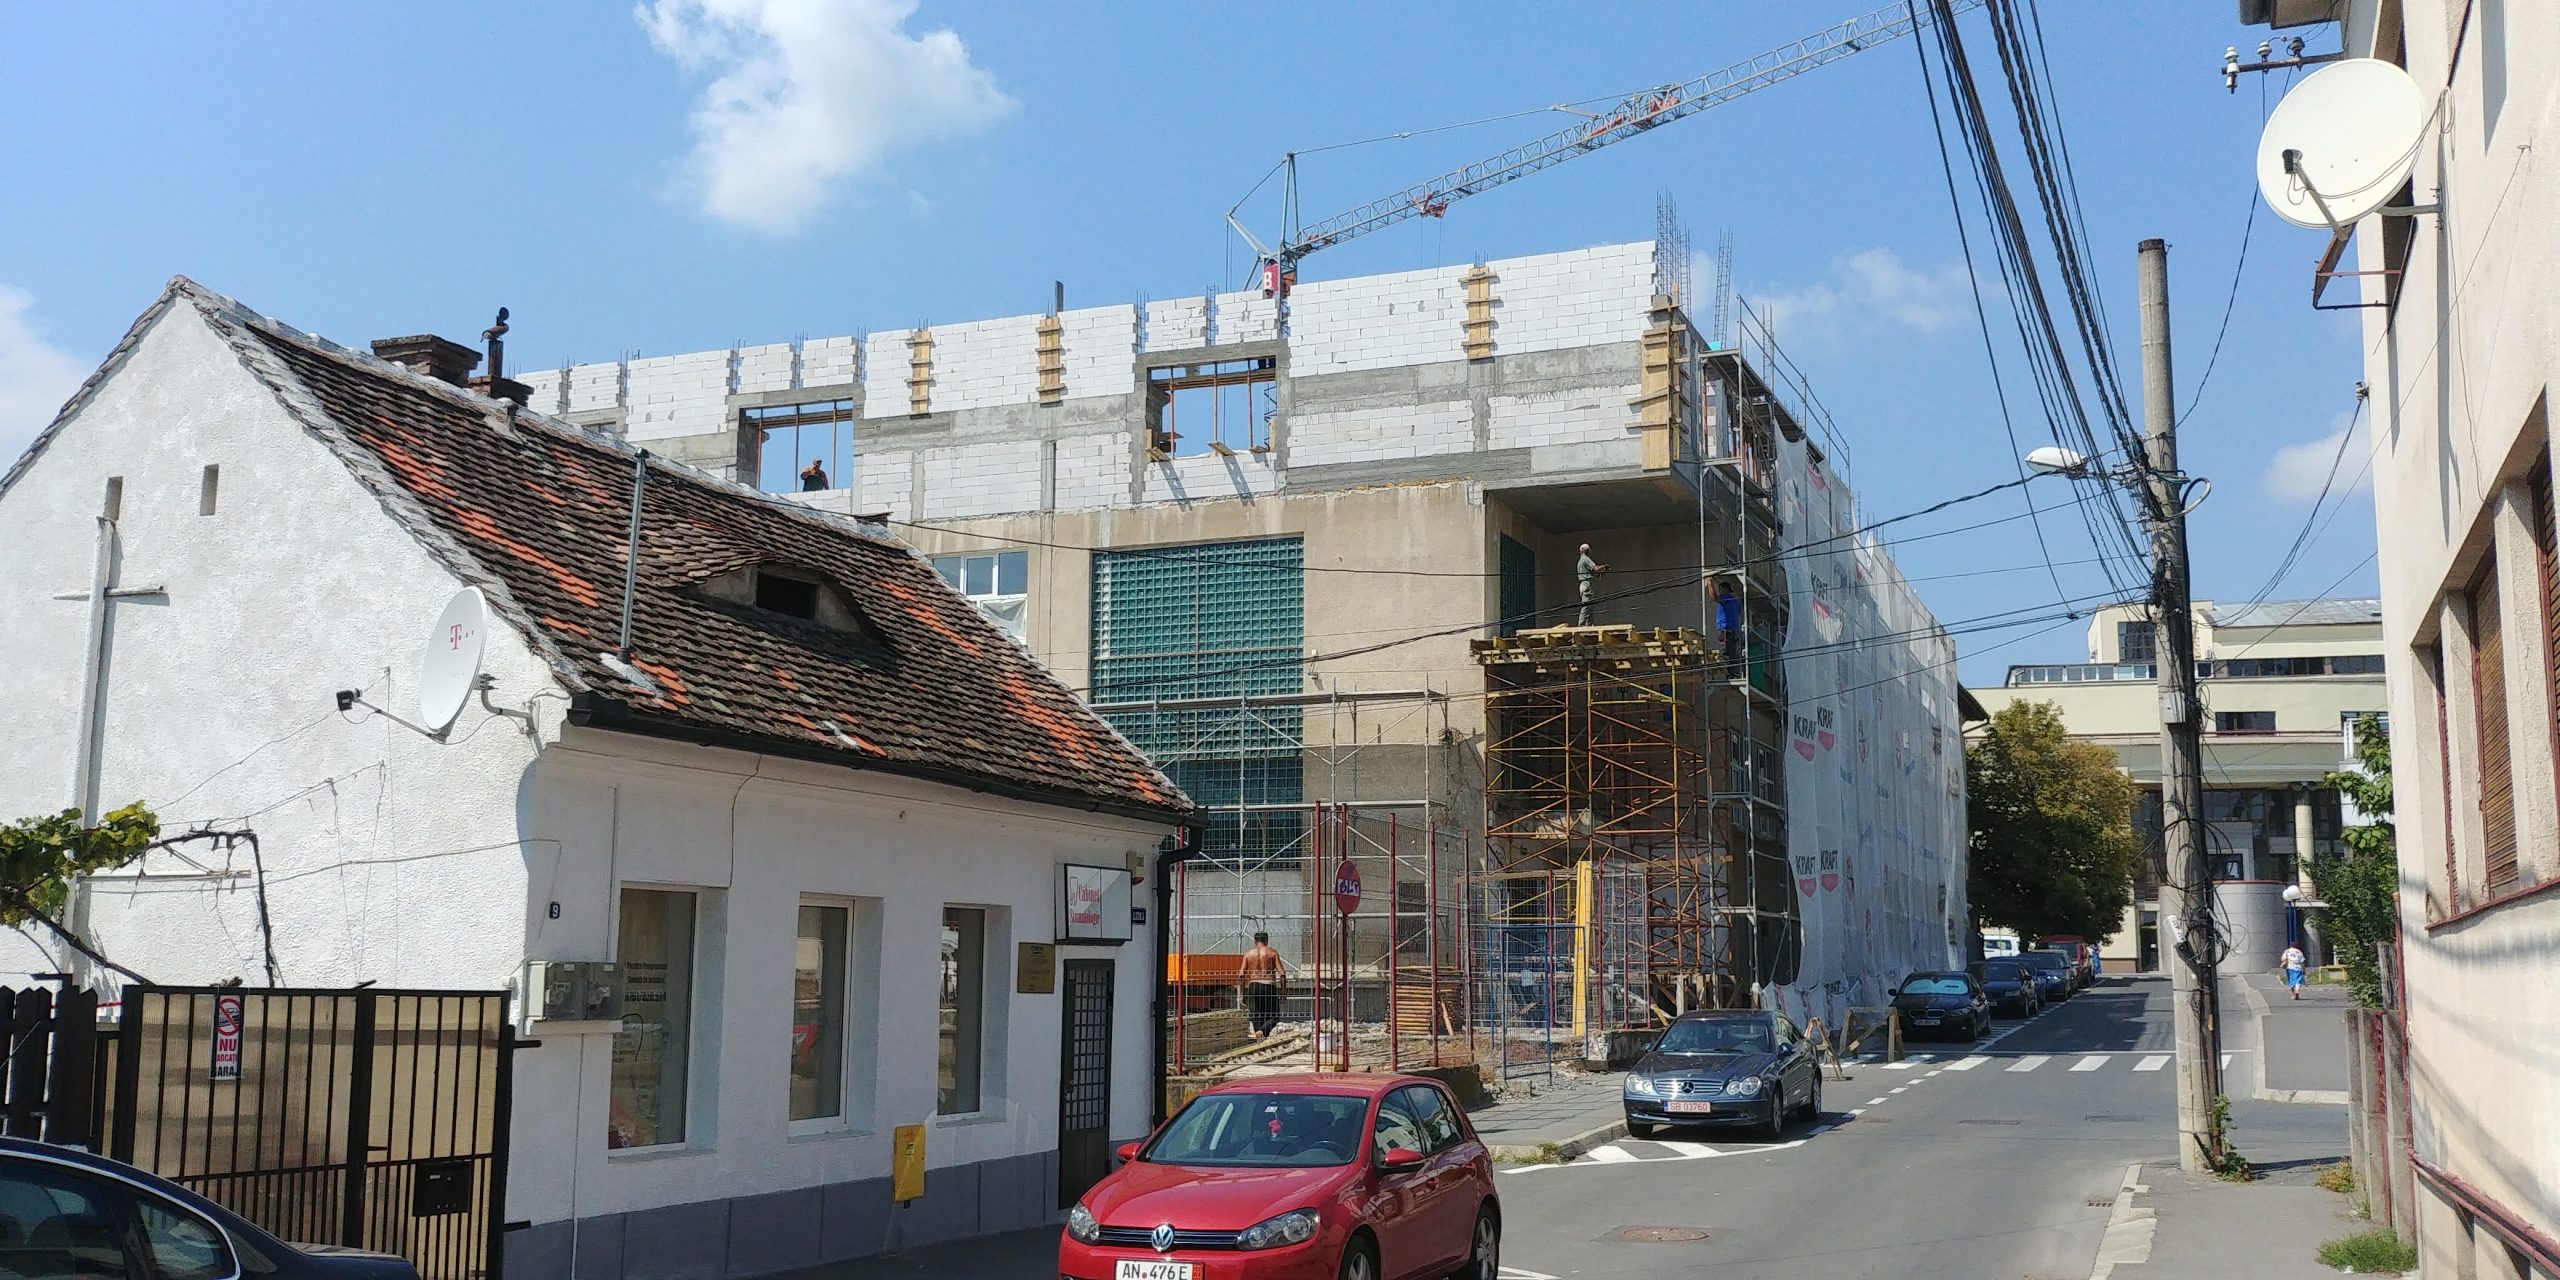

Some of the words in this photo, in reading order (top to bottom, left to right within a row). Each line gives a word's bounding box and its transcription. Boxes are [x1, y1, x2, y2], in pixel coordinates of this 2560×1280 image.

[1821, 850, 1838, 870] KRAFT
[219, 1039, 237, 1051] NU
[1670, 1103, 1681, 1111] SB
[1122, 1263, 1141, 1279] AN
